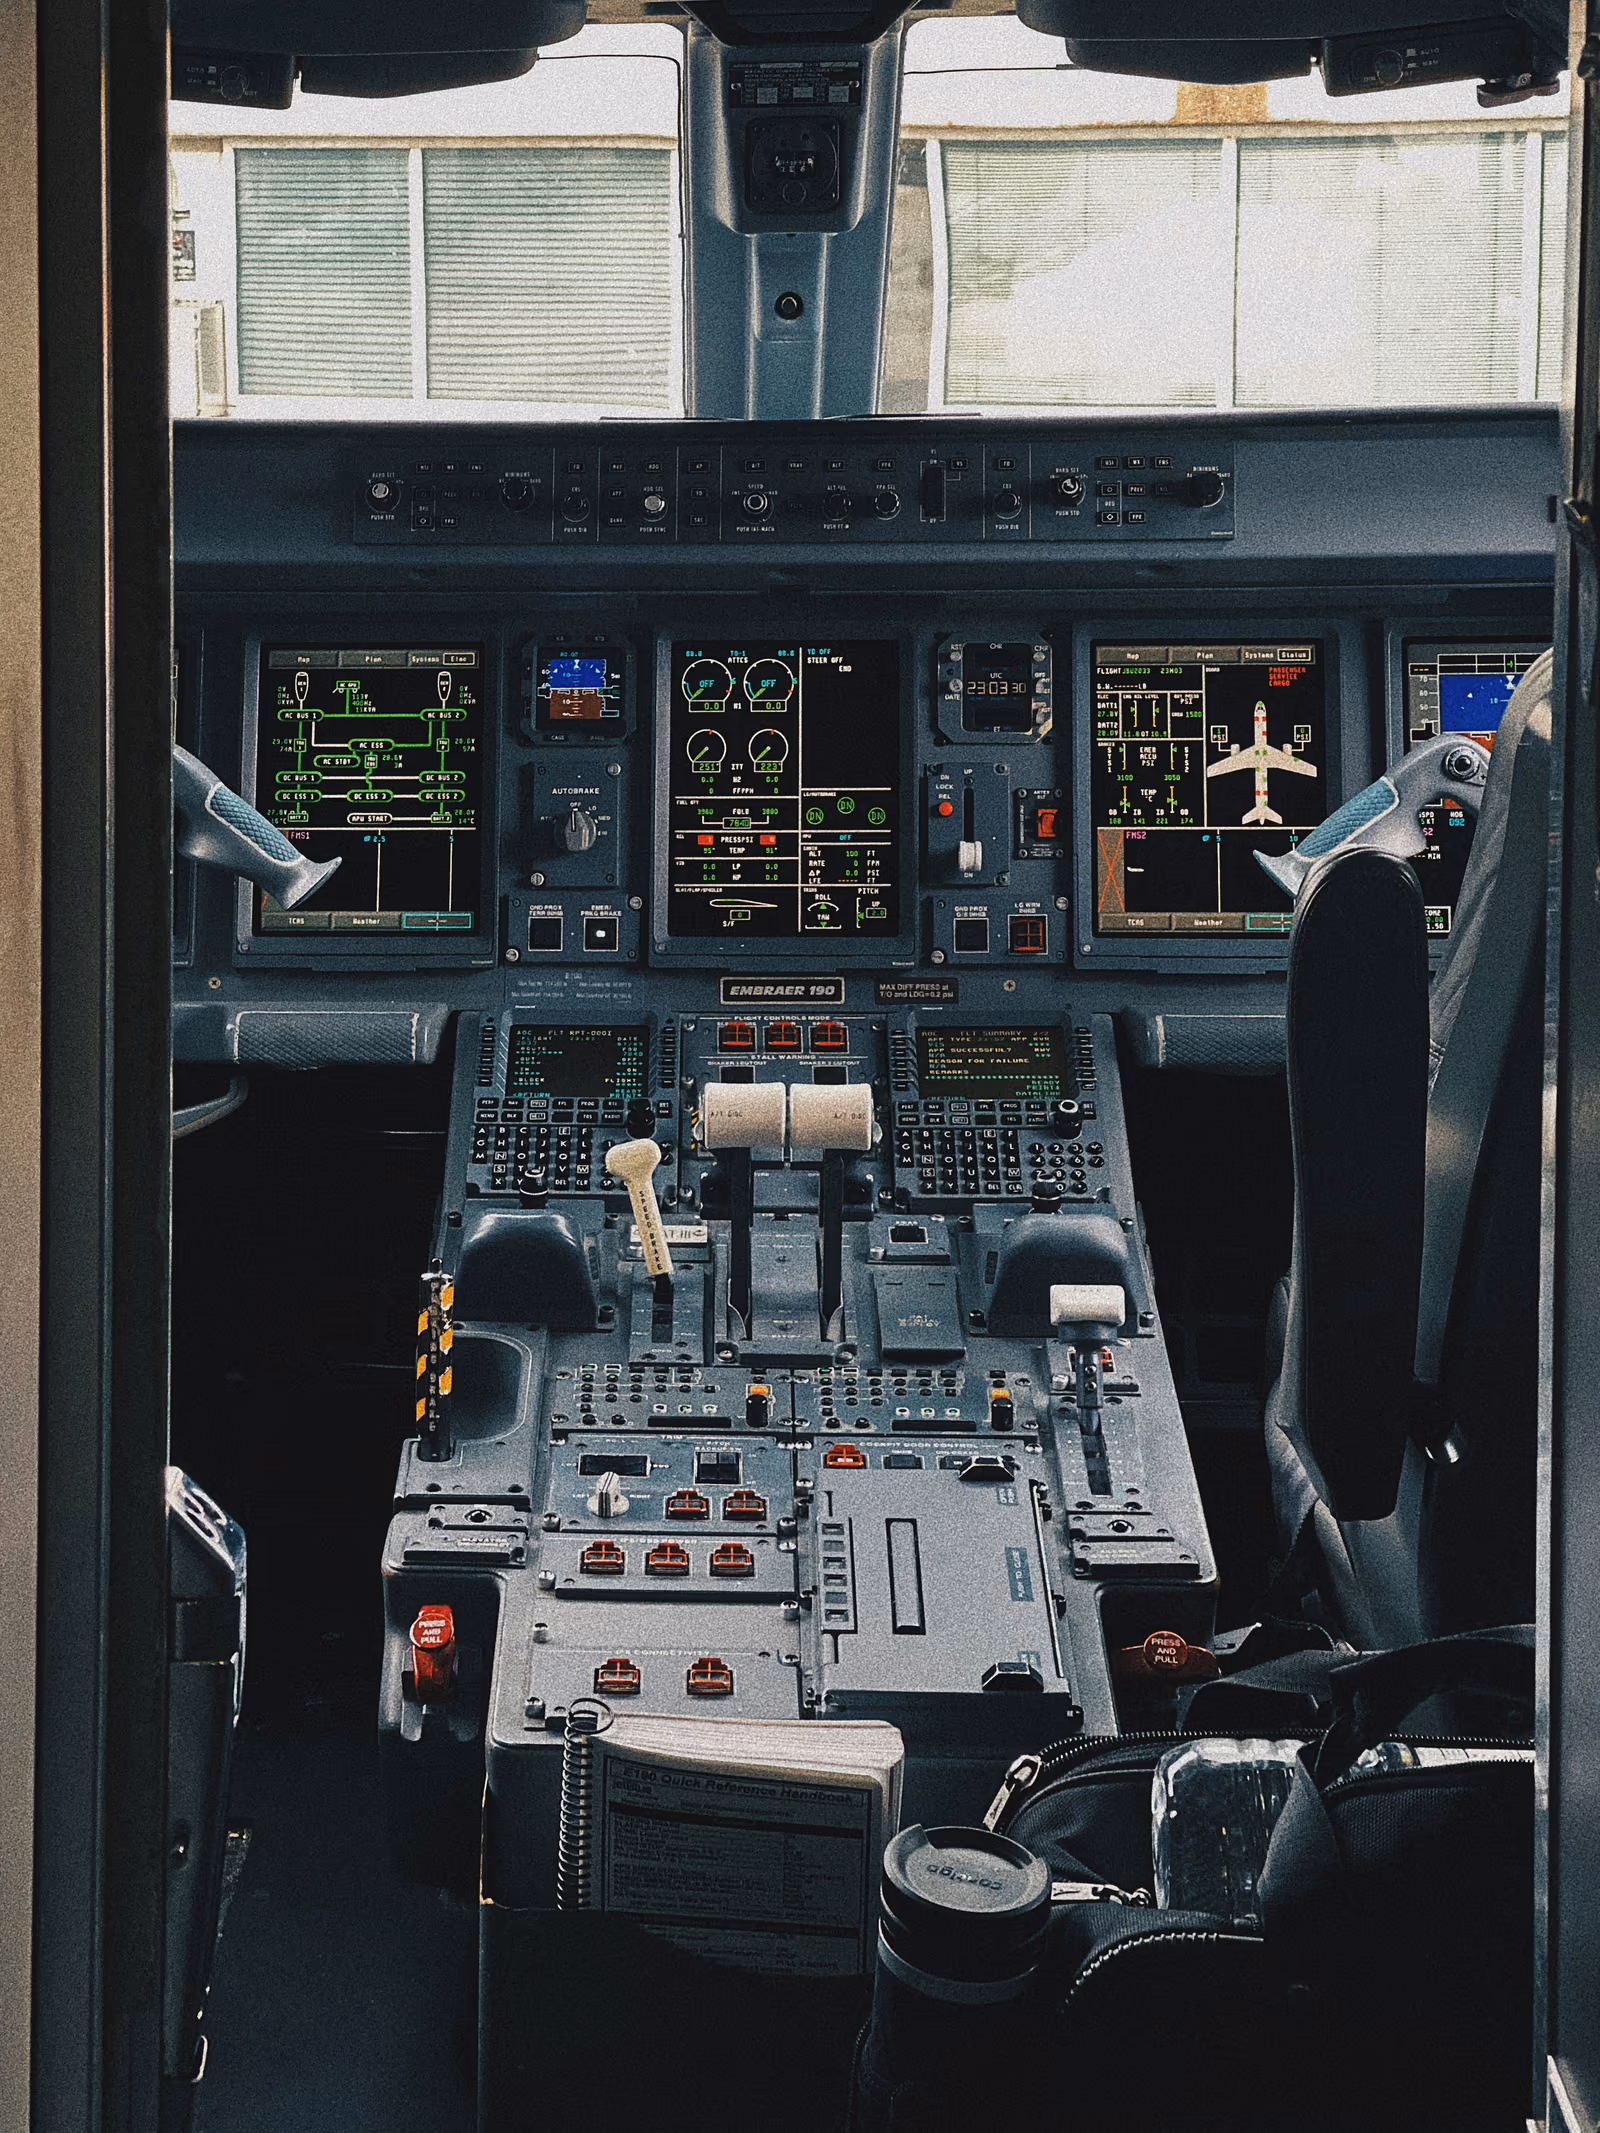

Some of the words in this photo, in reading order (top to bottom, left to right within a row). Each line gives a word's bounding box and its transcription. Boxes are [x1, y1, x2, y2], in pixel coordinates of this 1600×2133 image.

[297, 656, 310, 664] Map
[365, 655, 382, 663] Plan
[1197, 652, 1214, 660] Plan
[1245, 652, 1274, 660] Systems
[699, 680, 714, 688] OFF
[761, 679, 776, 687] OFF
[1012, 683, 1026, 693] 30
[704, 702, 720, 710] 0.0
[766, 702, 781, 710] 0.0
[840, 801, 853, 810] DN
[809, 812, 821, 821] DN
[871, 812, 883, 820] DN
[290, 832, 310, 840] FMS1
[1126, 831, 1147, 840] FMS2
[730, 985, 805, 996] EMBRAER
[810, 985, 835, 996] 190
[942, 991, 954, 999] psi
[639, 1191, 652, 1228] SPEED
[649, 1232, 663, 1271] BRAKE
[1016, 1570, 1022, 1580] TO
[419, 1620, 445, 1628] PRESS
[420, 1636, 443, 1644] PULL
[1157, 1647, 1176, 1655] AND
[1155, 1655, 1178, 1664] PULL
[662, 1774, 701, 1790] Quick
[704, 1780, 777, 1797] Reference
[781, 1787, 850, 1803] Handbook
